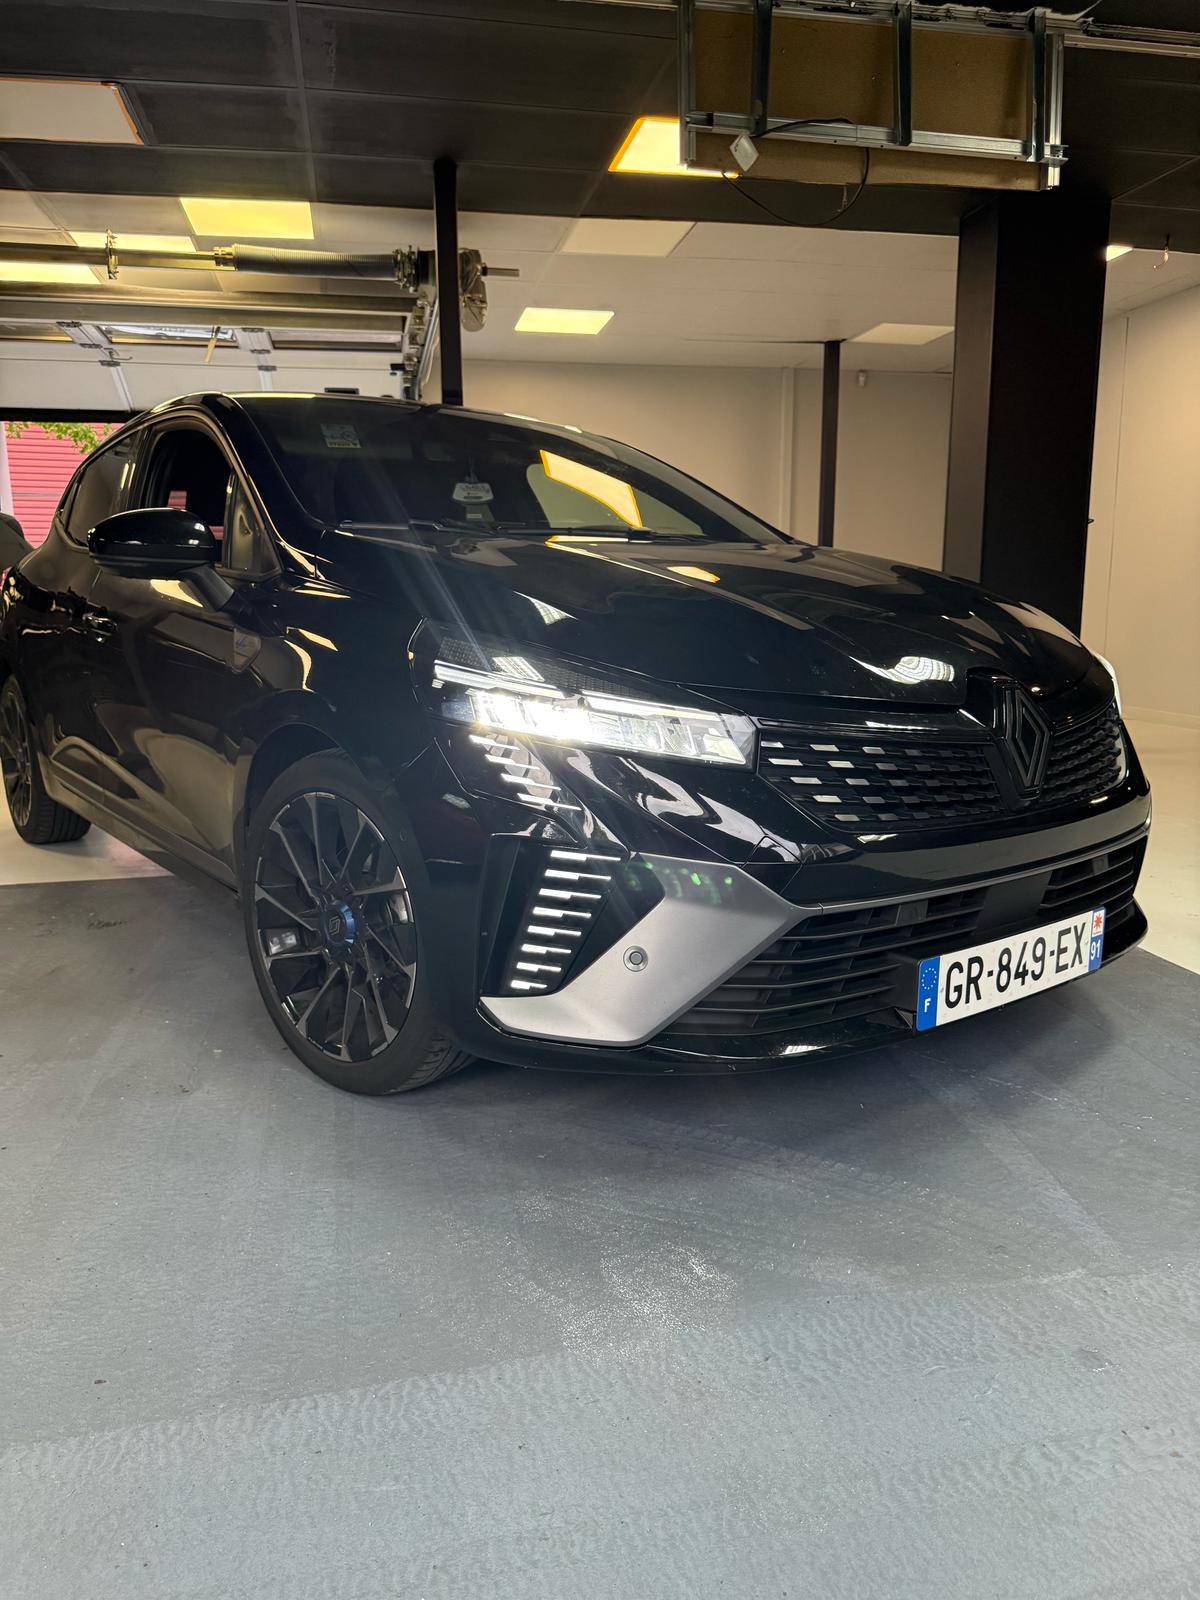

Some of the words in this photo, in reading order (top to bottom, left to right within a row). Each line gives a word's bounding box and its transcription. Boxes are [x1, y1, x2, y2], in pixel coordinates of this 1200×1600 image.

[1091, 940, 1101, 960] 91
[945, 922, 1086, 1009] GR-849-EX
[924, 998, 931, 1012] F
